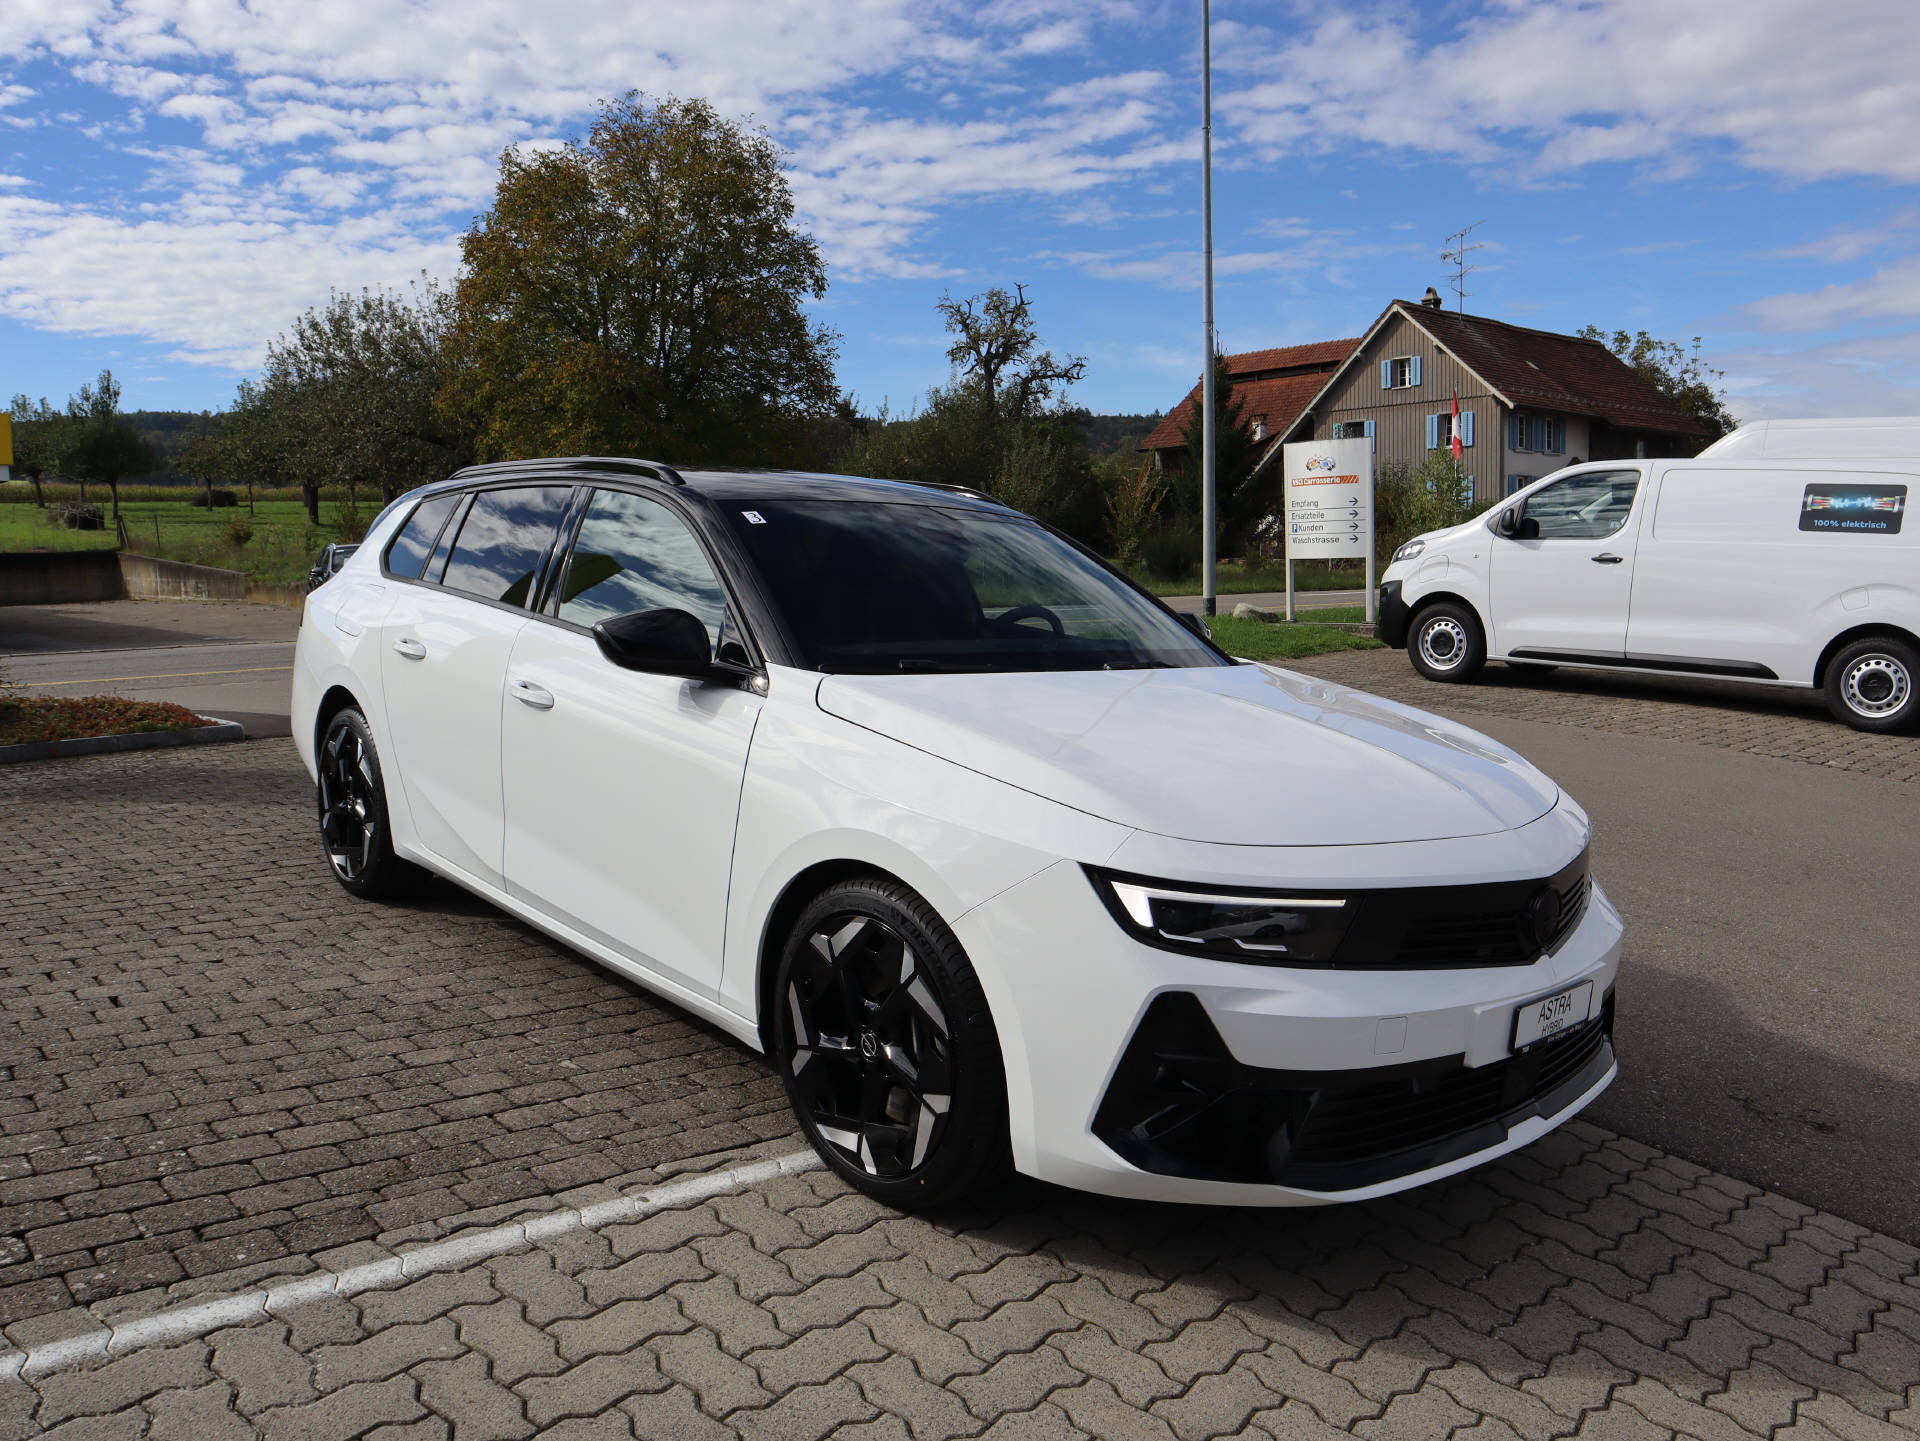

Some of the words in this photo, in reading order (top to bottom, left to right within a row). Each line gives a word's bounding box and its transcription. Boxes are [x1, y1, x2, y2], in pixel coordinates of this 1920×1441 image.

[1303, 477, 1340, 485] Carrosserie
[1291, 500, 1319, 508] Empfang
[1291, 512, 1325, 520] Ersatzteile
[1298, 524, 1324, 532] Kunden
[1813, 519, 1839, 528] 100%
[1841, 520, 1887, 529] elektrisch
[1292, 536, 1340, 544] Waschstrasse
[1538, 992, 1571, 1023] ASTRA
